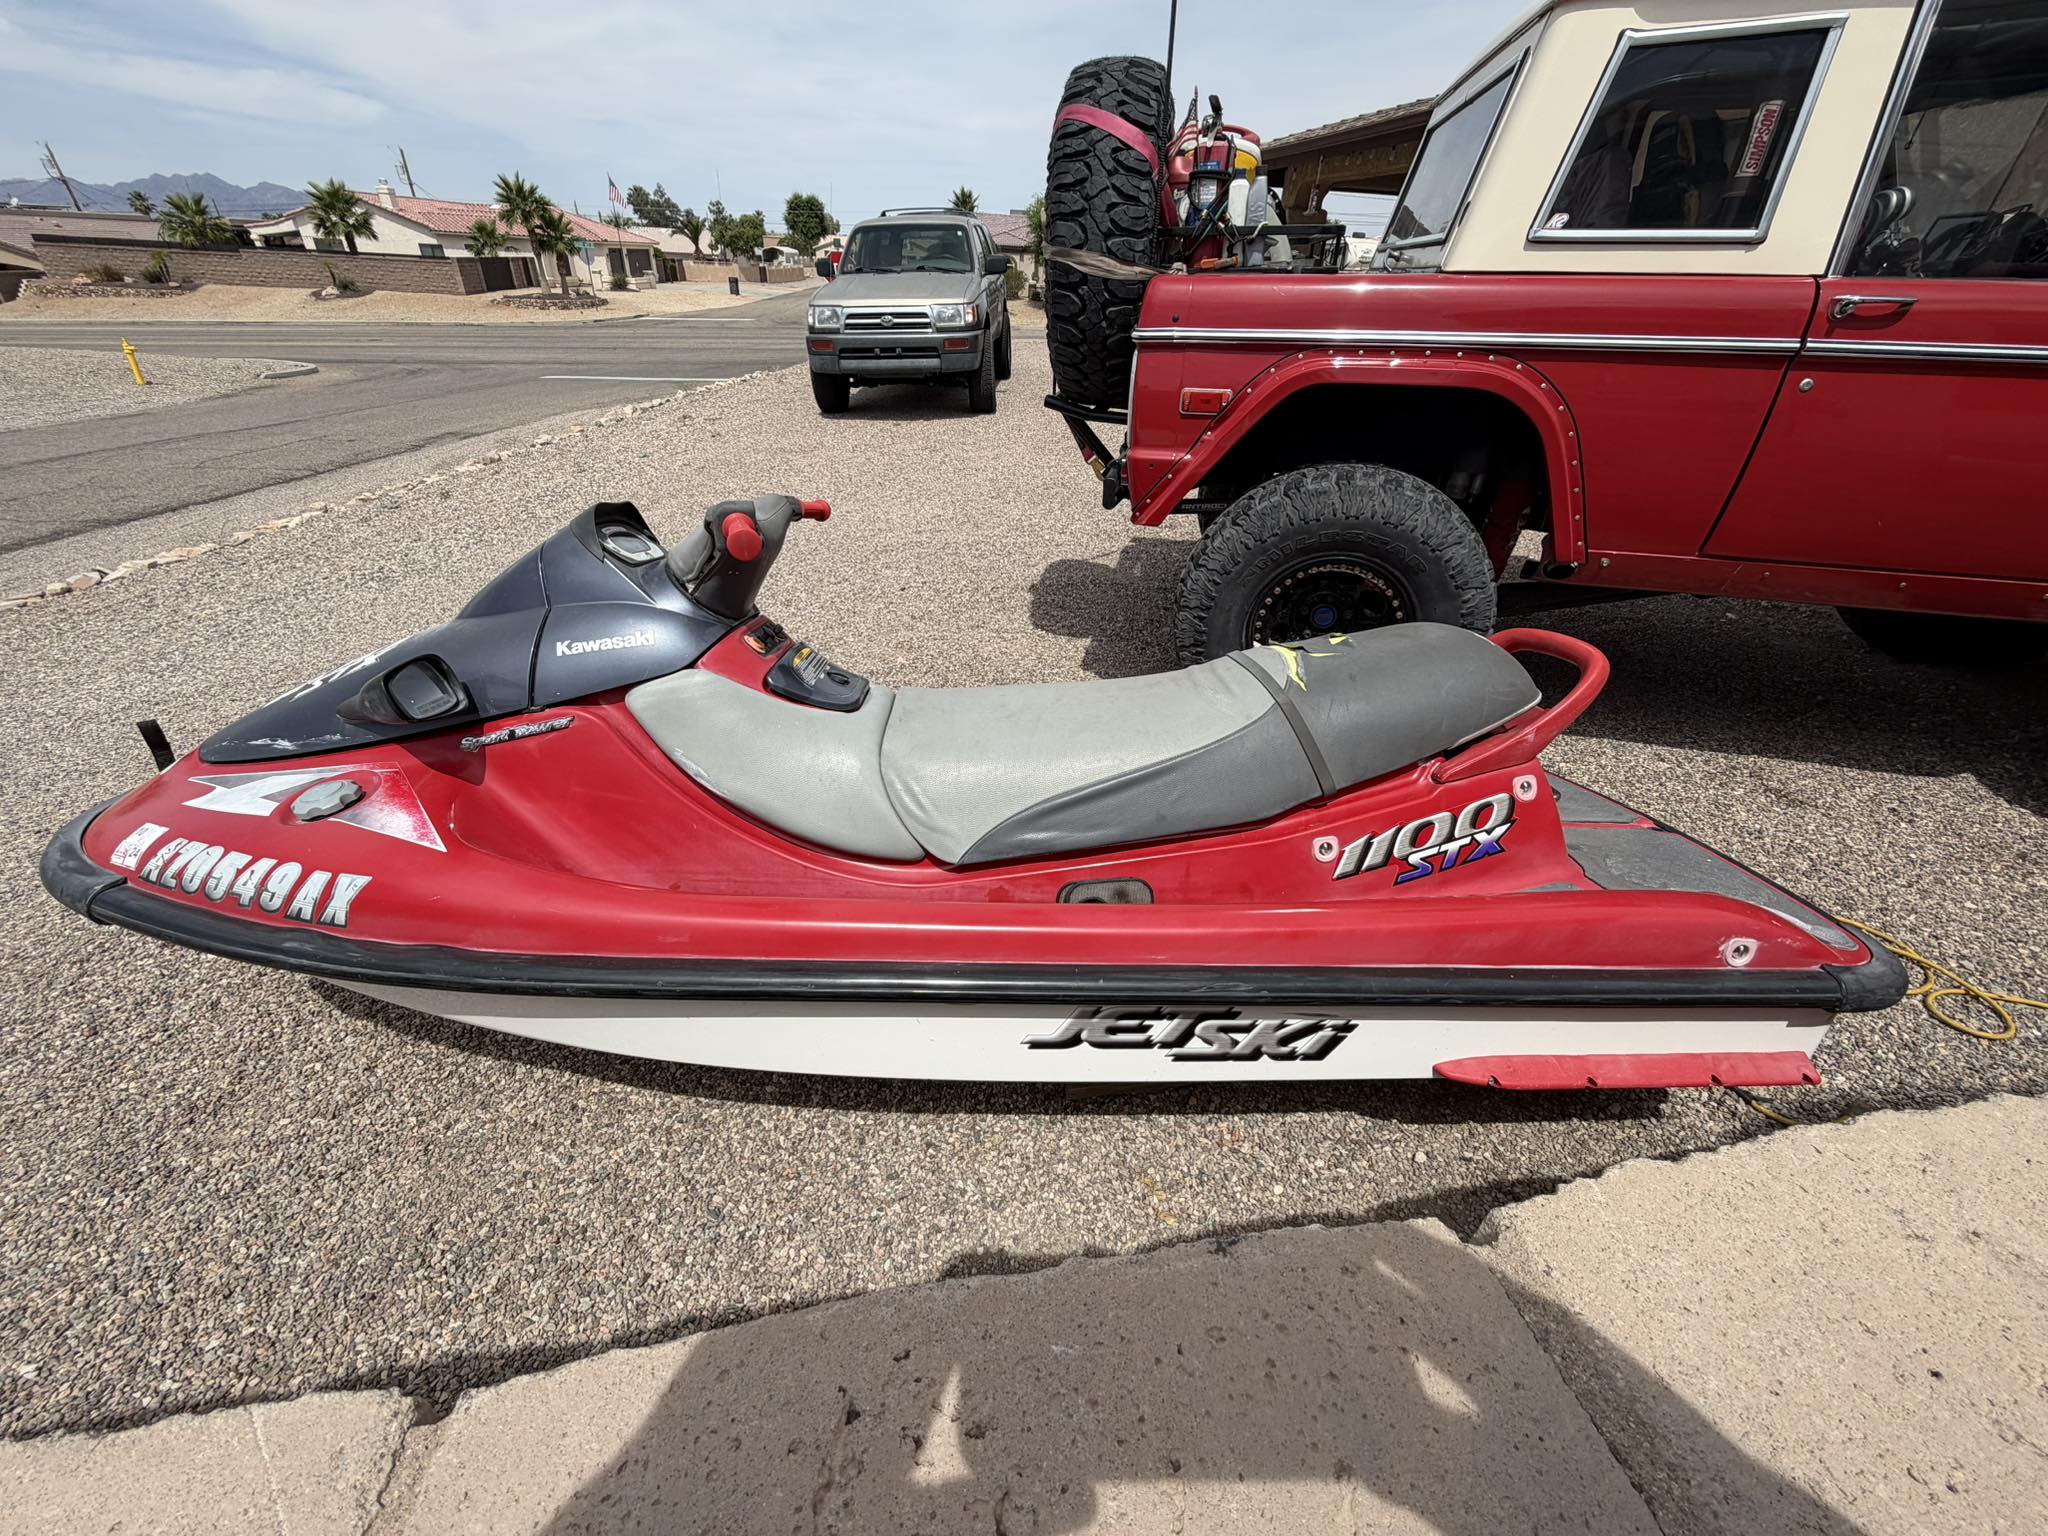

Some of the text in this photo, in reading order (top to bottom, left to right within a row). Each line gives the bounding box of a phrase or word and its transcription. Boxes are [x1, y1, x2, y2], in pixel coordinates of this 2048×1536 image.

[1745, 109, 1778, 169] SIMPSON
[556, 630, 656, 657] Kawasaki
[1332, 793, 1516, 880] 1100
[1393, 818, 1518, 887] STX
